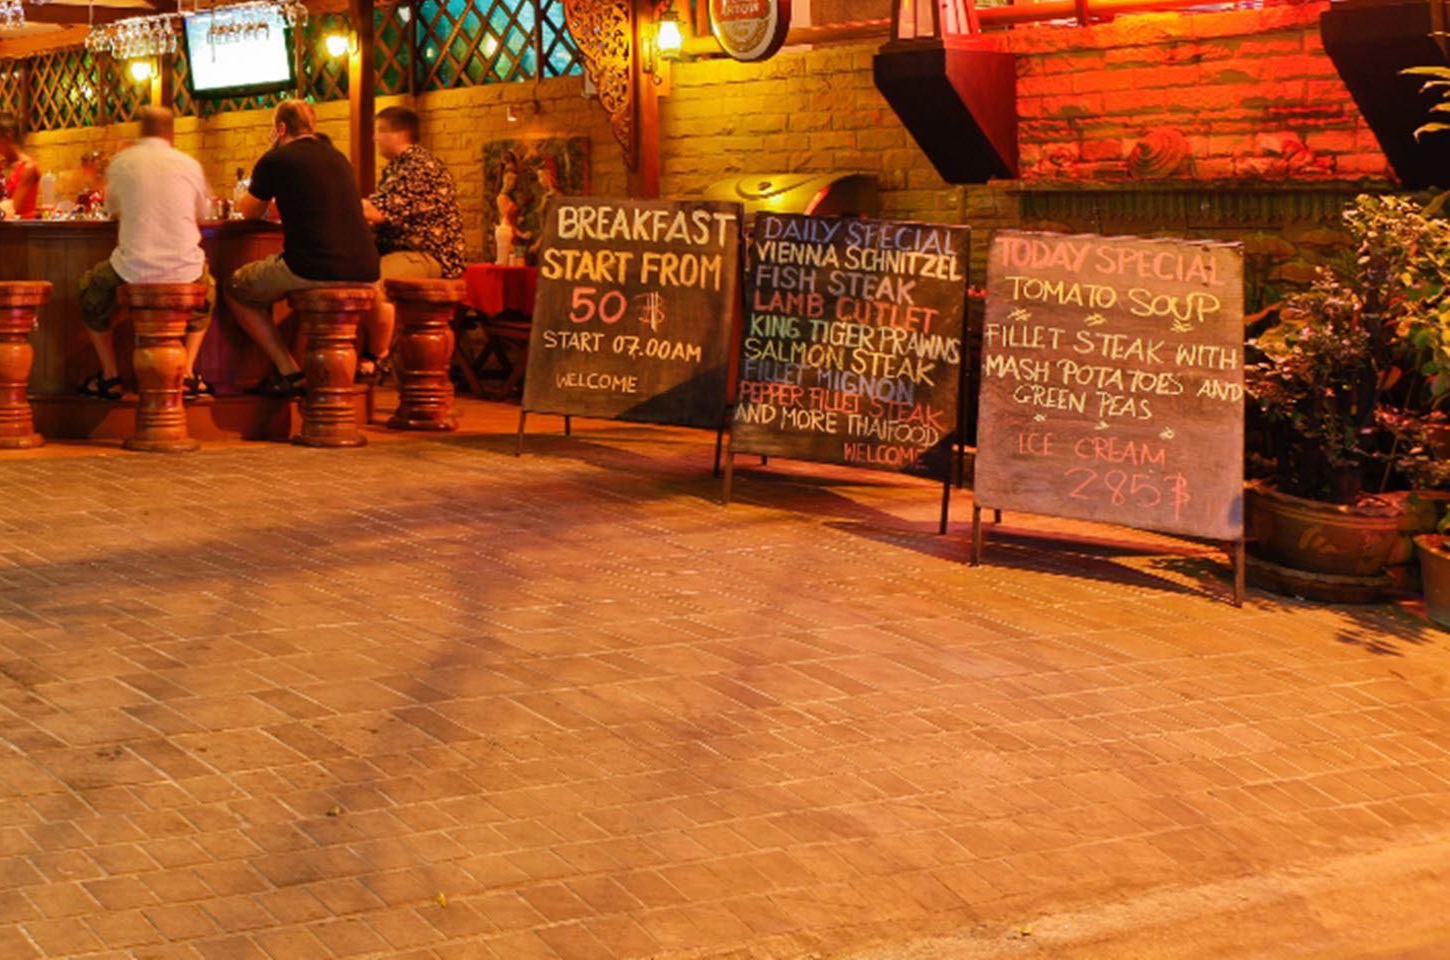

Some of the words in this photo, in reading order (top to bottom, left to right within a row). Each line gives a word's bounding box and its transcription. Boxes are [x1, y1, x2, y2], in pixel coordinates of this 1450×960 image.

[558, 206, 737, 248] BREAKFAST
[764, 216, 842, 243] DAILY
[846, 219, 958, 256] SPECIAL
[541, 247, 634, 286] START
[640, 251, 722, 291] FROM
[756, 241, 840, 268] VIENNA
[844, 245, 963, 282] SCHNITZEL
[995, 237, 1094, 273] TODAY
[1095, 244, 1225, 286] SPECIAL
[568, 286, 628, 324] 50
[756, 265, 816, 292] FISH
[827, 271, 917, 305] STEAK
[1006, 275, 1117, 309] TOMATO
[1128, 288, 1221, 323] SOUP
[753, 290, 824, 317] LAMB
[835, 297, 939, 334] CUTLET
[543, 330, 605, 353] START
[750, 313, 800, 339] KING
[809, 319, 875, 350] TIGER
[878, 326, 962, 365] PRAWNS
[984, 323, 1065, 350] FILLET
[1073, 330, 1165, 365] STEAK
[1175, 343, 1238, 370] WITH
[556, 372, 639, 394] WELCOME
[743, 358, 811, 385] FILLET
[817, 369, 915, 407] MIGNON
[744, 338, 845, 371] SALMON
[851, 348, 936, 387] STEAK
[984, 354, 1050, 382] MASH
[1056, 359, 1184, 395] POTATOES
[1196, 379, 1243, 403] AND
[734, 404, 777, 425] AND
[780, 406, 838, 433] MORE
[739, 380, 805, 409] PEPPER
[809, 386, 861, 414] FILLET
[869, 394, 948, 433] STEAK
[1013, 384, 1086, 414] GREEN
[1097, 390, 1152, 420] PEAS
[844, 442, 928, 469] WELCOME
[1018, 432, 1054, 456] ICE
[1074, 436, 1166, 466] CREAM
